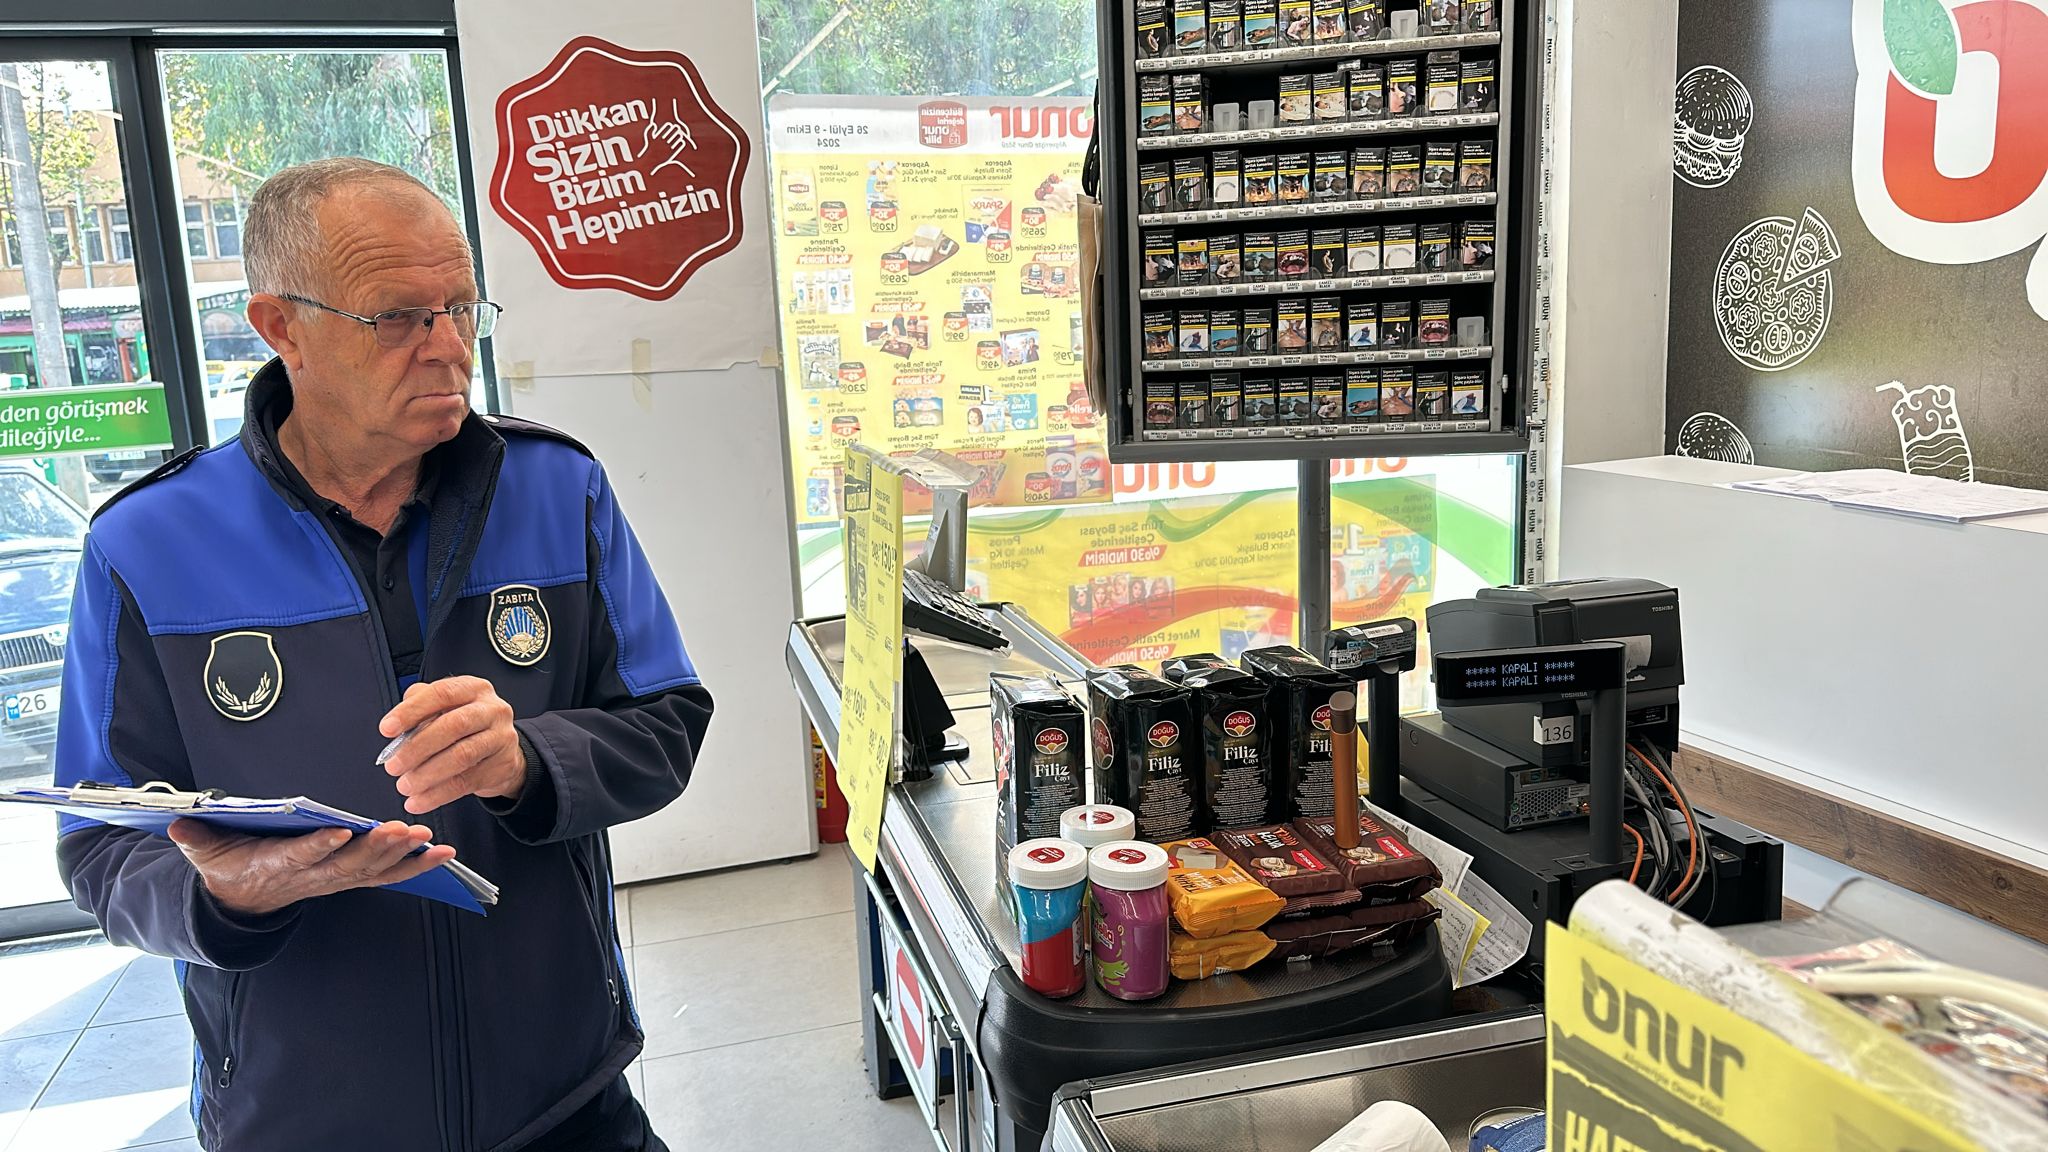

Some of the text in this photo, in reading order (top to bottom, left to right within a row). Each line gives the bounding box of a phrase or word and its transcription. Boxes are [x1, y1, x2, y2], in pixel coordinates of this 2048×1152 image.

[527, 98, 649, 144] Dükkan
[526, 133, 633, 183] Sizin
[548, 169, 646, 211] Bizim
[547, 185, 721, 250] Hepimizin
[45, 397, 149, 426] görüşmek
[1528, 509, 1536, 533] HUUN
[498, 593, 535, 606] ZABITA
[1501, 663, 1538, 674] KAPALI
[1501, 676, 1538, 687] KAPALI
[21, 693, 47, 715] 26
[1228, 715, 1250, 725] DOĞUŞ
[1316, 709, 1331, 718] DOĞ
[1039, 734, 1063, 742] DOĞUŞ
[1152, 726, 1175, 736] DOĞUŞ
[1544, 726, 1572, 742] 136
[1223, 745, 1259, 761] Filiz
[1034, 763, 1071, 778] Filiz
[1147, 755, 1182, 772] Filiz
[1582, 960, 1746, 1100] onur
